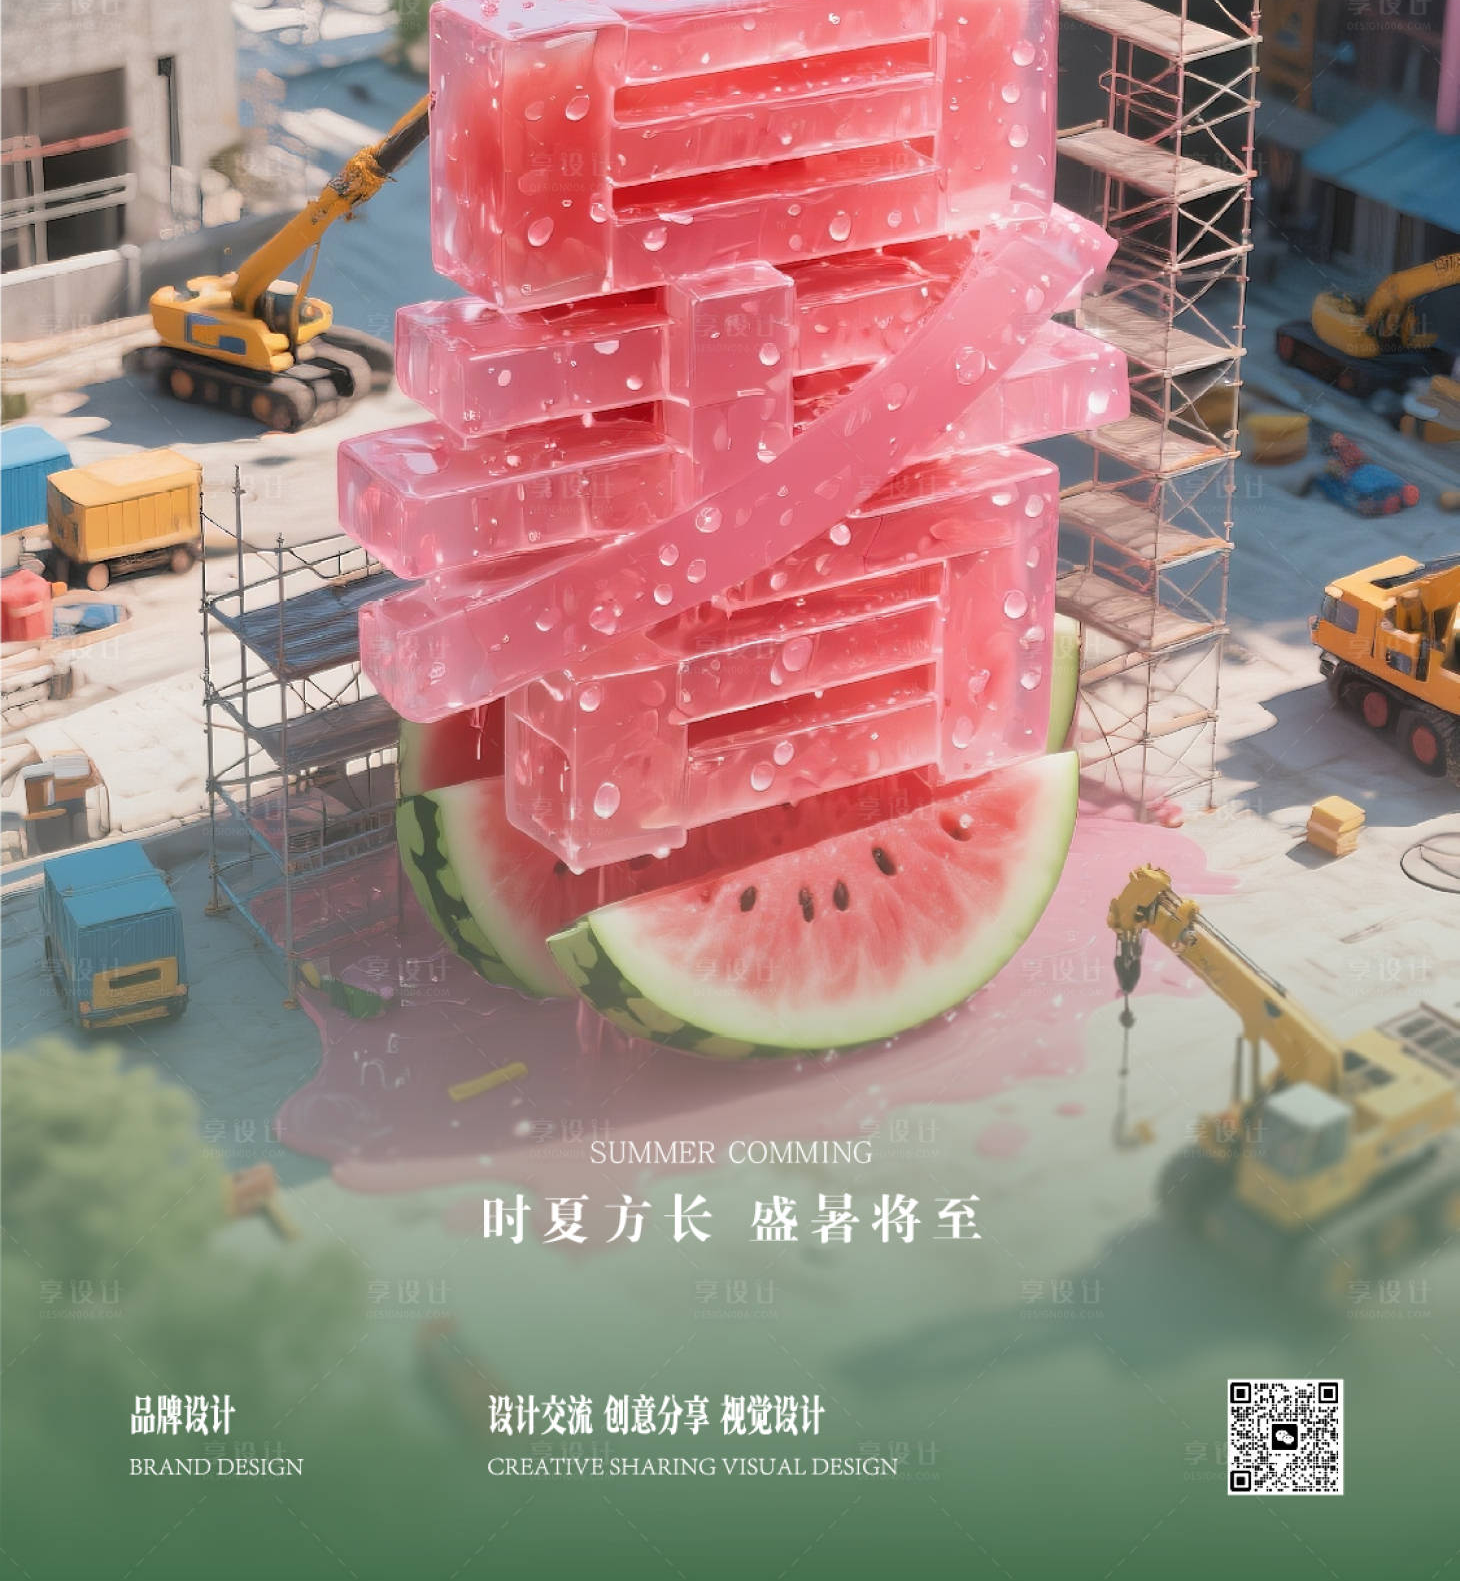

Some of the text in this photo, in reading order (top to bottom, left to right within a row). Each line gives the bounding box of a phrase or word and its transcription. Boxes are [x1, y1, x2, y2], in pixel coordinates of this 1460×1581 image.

[590, 1140, 872, 1164] SUMMER COMMING
[482, 1192, 983, 1245] 时夏方长 盛暑将至
[130, 1394, 236, 1436] 品牌设计
[488, 1393, 825, 1436] 设计交流 创意分享 视觉设计
[130, 1457, 304, 1476] BRAND DESIGN
[487, 1457, 898, 1476] CREATIVE SHARING VISUAL DESIGN
